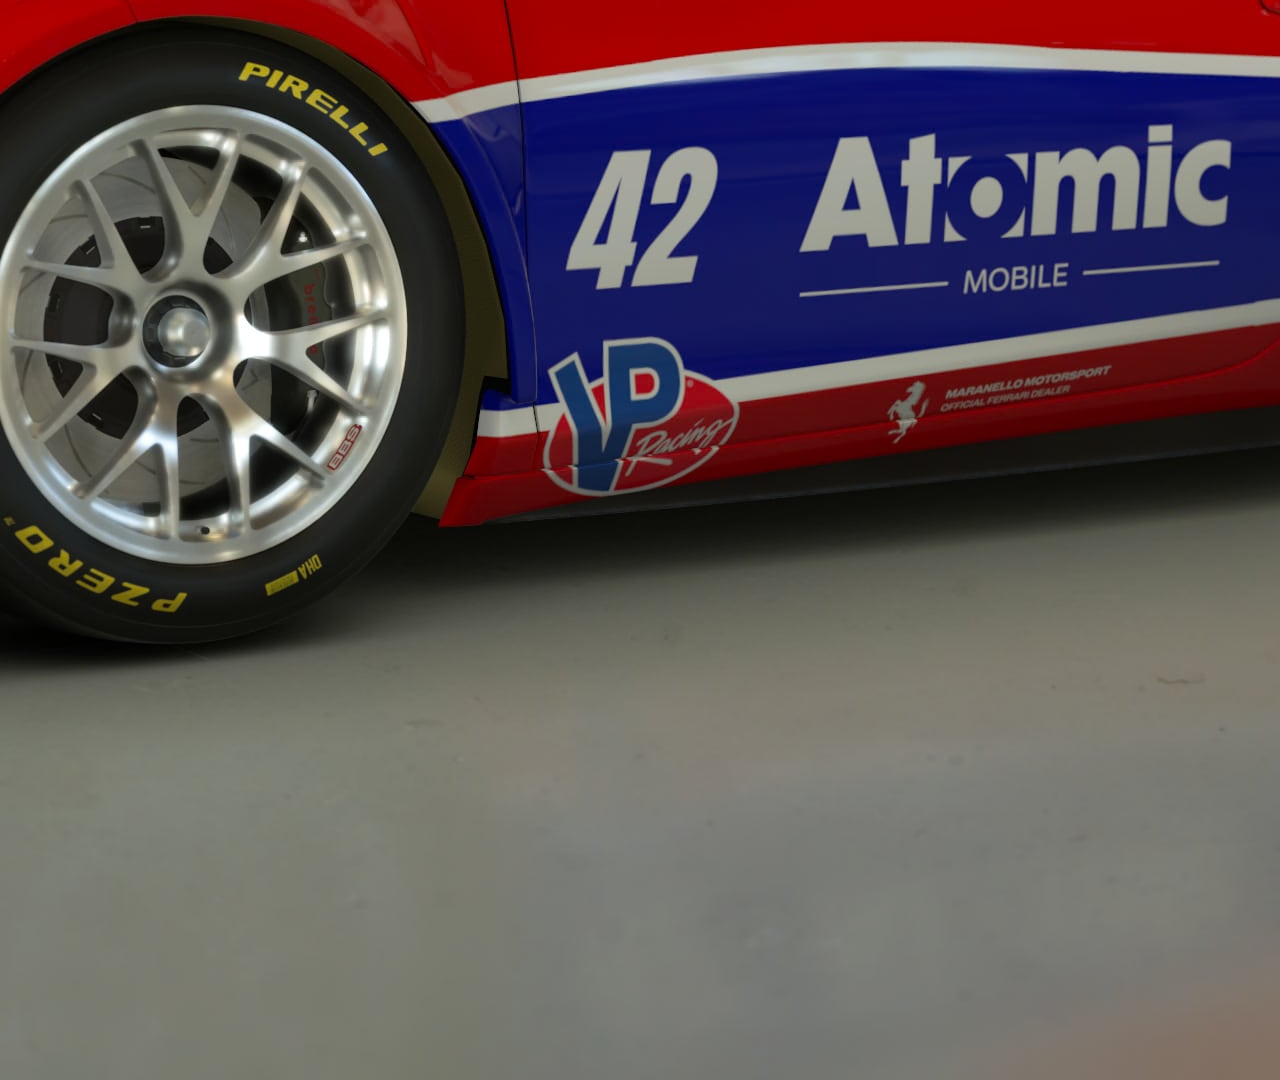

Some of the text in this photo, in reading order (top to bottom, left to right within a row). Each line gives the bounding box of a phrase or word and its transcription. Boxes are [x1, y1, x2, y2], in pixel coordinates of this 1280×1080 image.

[238, 61, 389, 157] PIRELLI
[566, 146, 718, 290] 42
[799, 124, 1232, 253] Atomic
[963, 262, 1069, 295] MOBILE
[549, 337, 685, 494] VP
[940, 385, 1071, 413] OFFICIAL FERRARI DEALER
[944, 365, 1112, 400] MARANELLO MOTORSPORT
[626, 418, 734, 477] Racing
